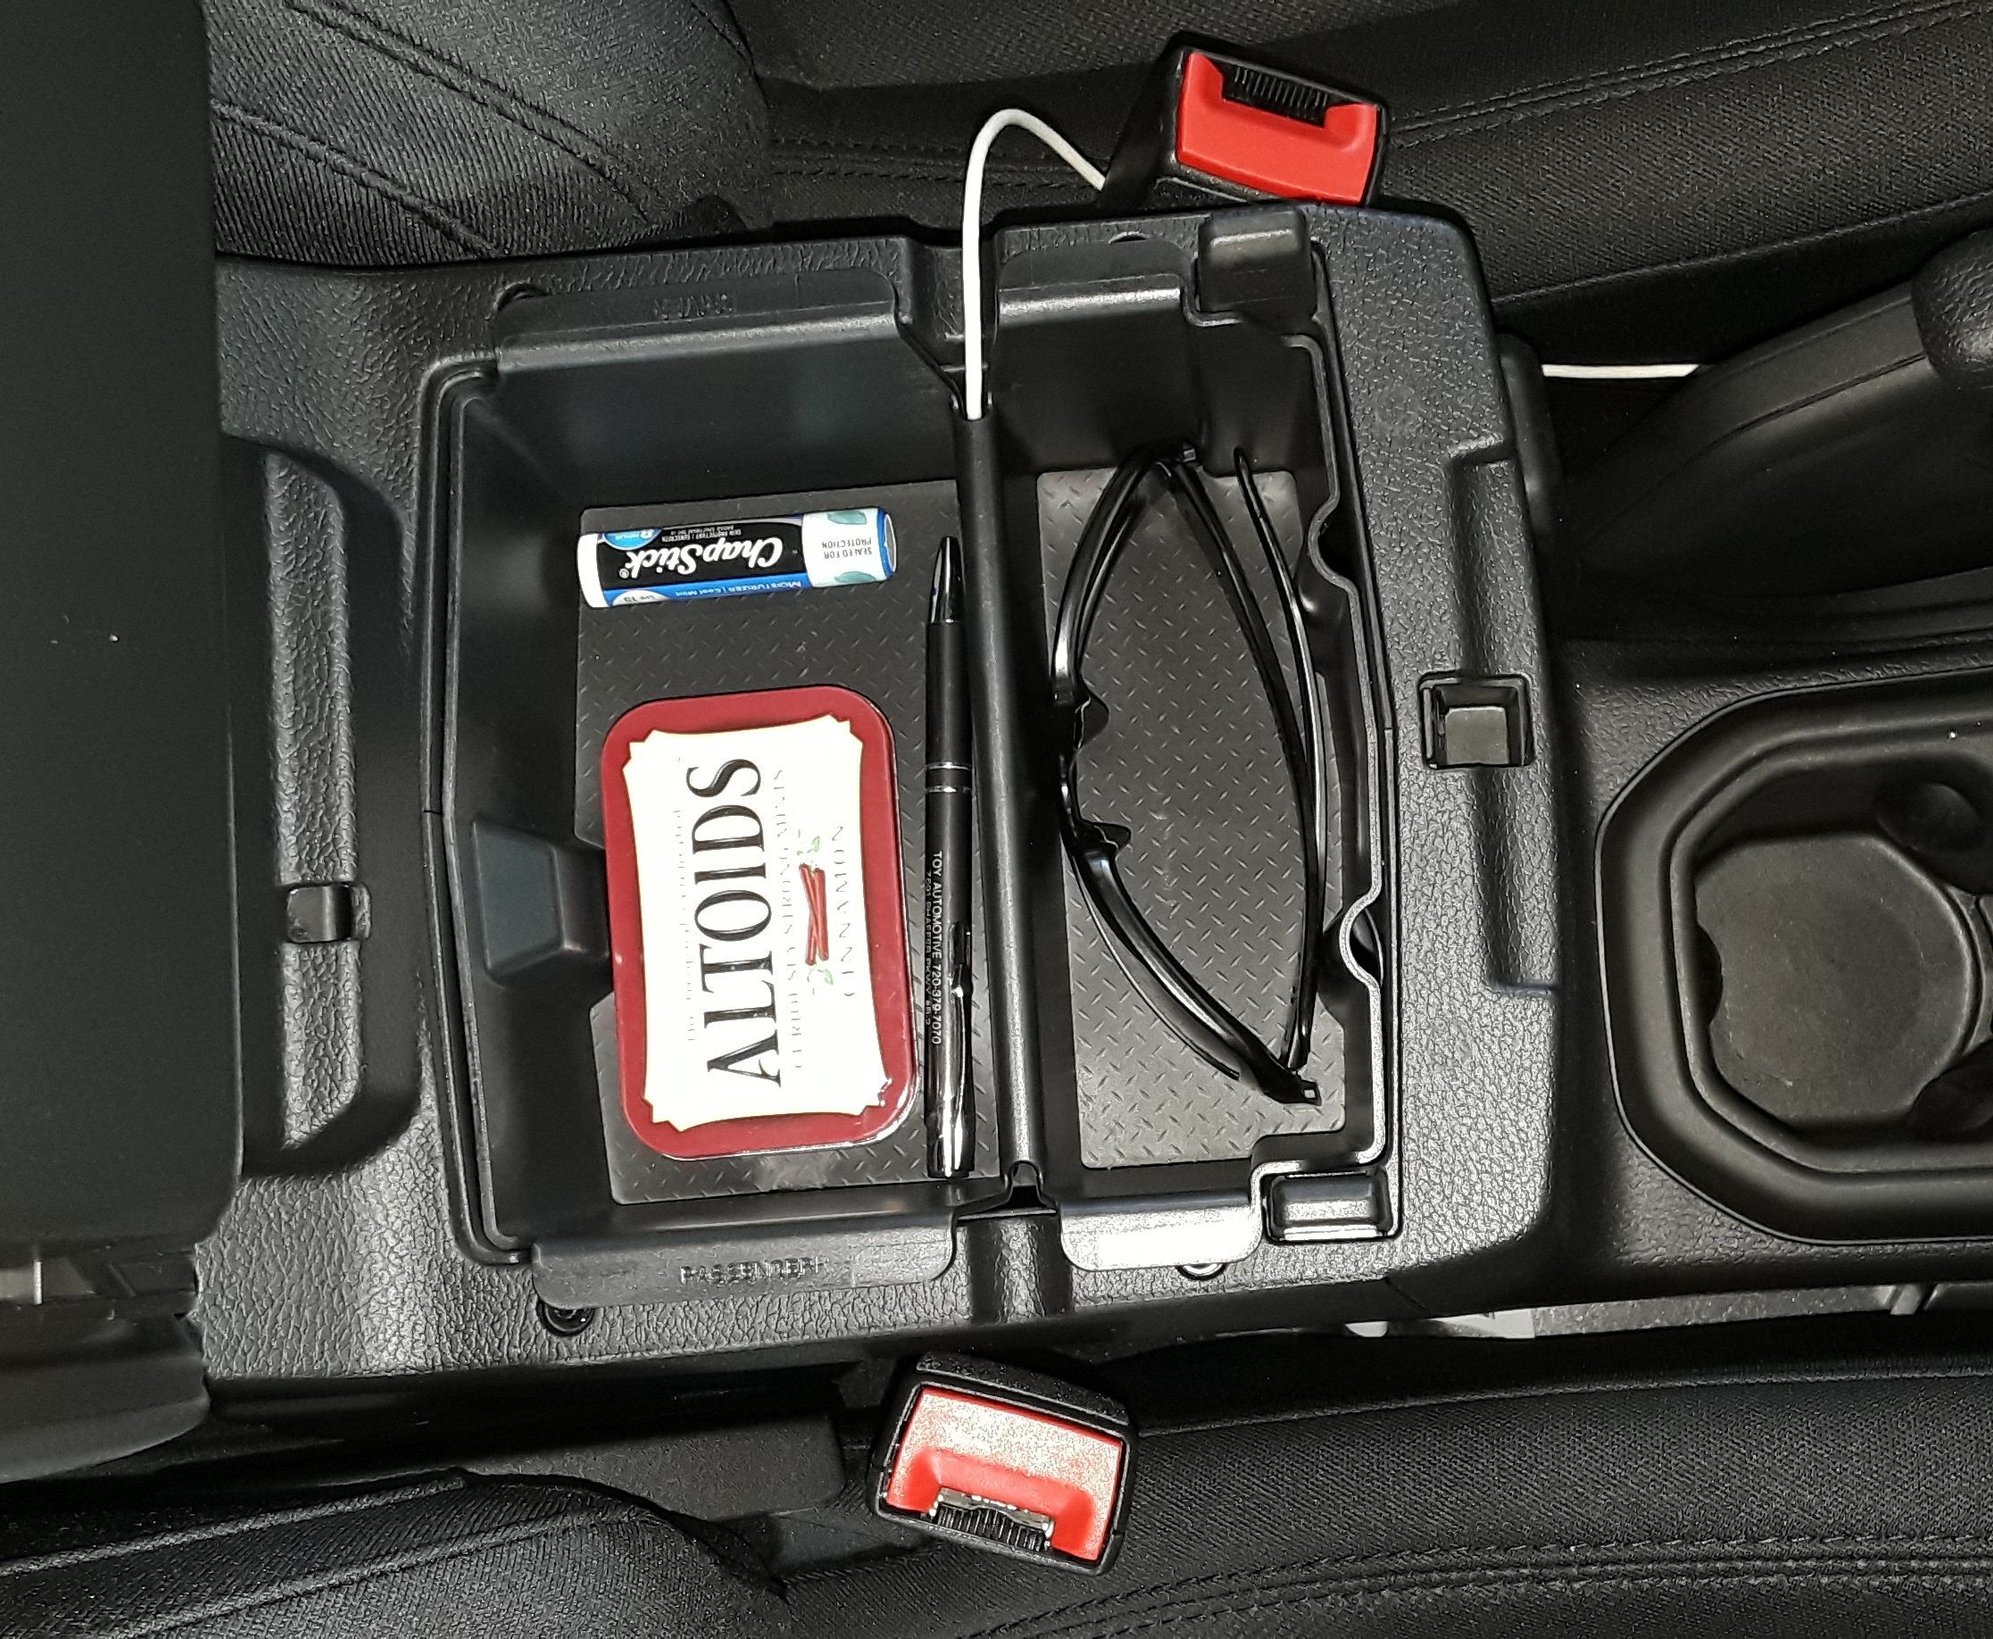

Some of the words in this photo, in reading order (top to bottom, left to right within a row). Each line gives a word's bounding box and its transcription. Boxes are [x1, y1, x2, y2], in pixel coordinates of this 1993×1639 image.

[624, 537, 783, 578] ChapStick
[821, 538, 871, 549] PROTECTION
[824, 551, 840, 560] FOR
[843, 547, 872, 558] SEALED
[932, 850, 943, 877] TOY
[686, 759, 781, 1087] ALTOIDS
[832, 825, 856, 998] CINNAMON
[931, 882, 943, 959] AUTOMOTIVE
[931, 963, 942, 1045] 720-379-7070
